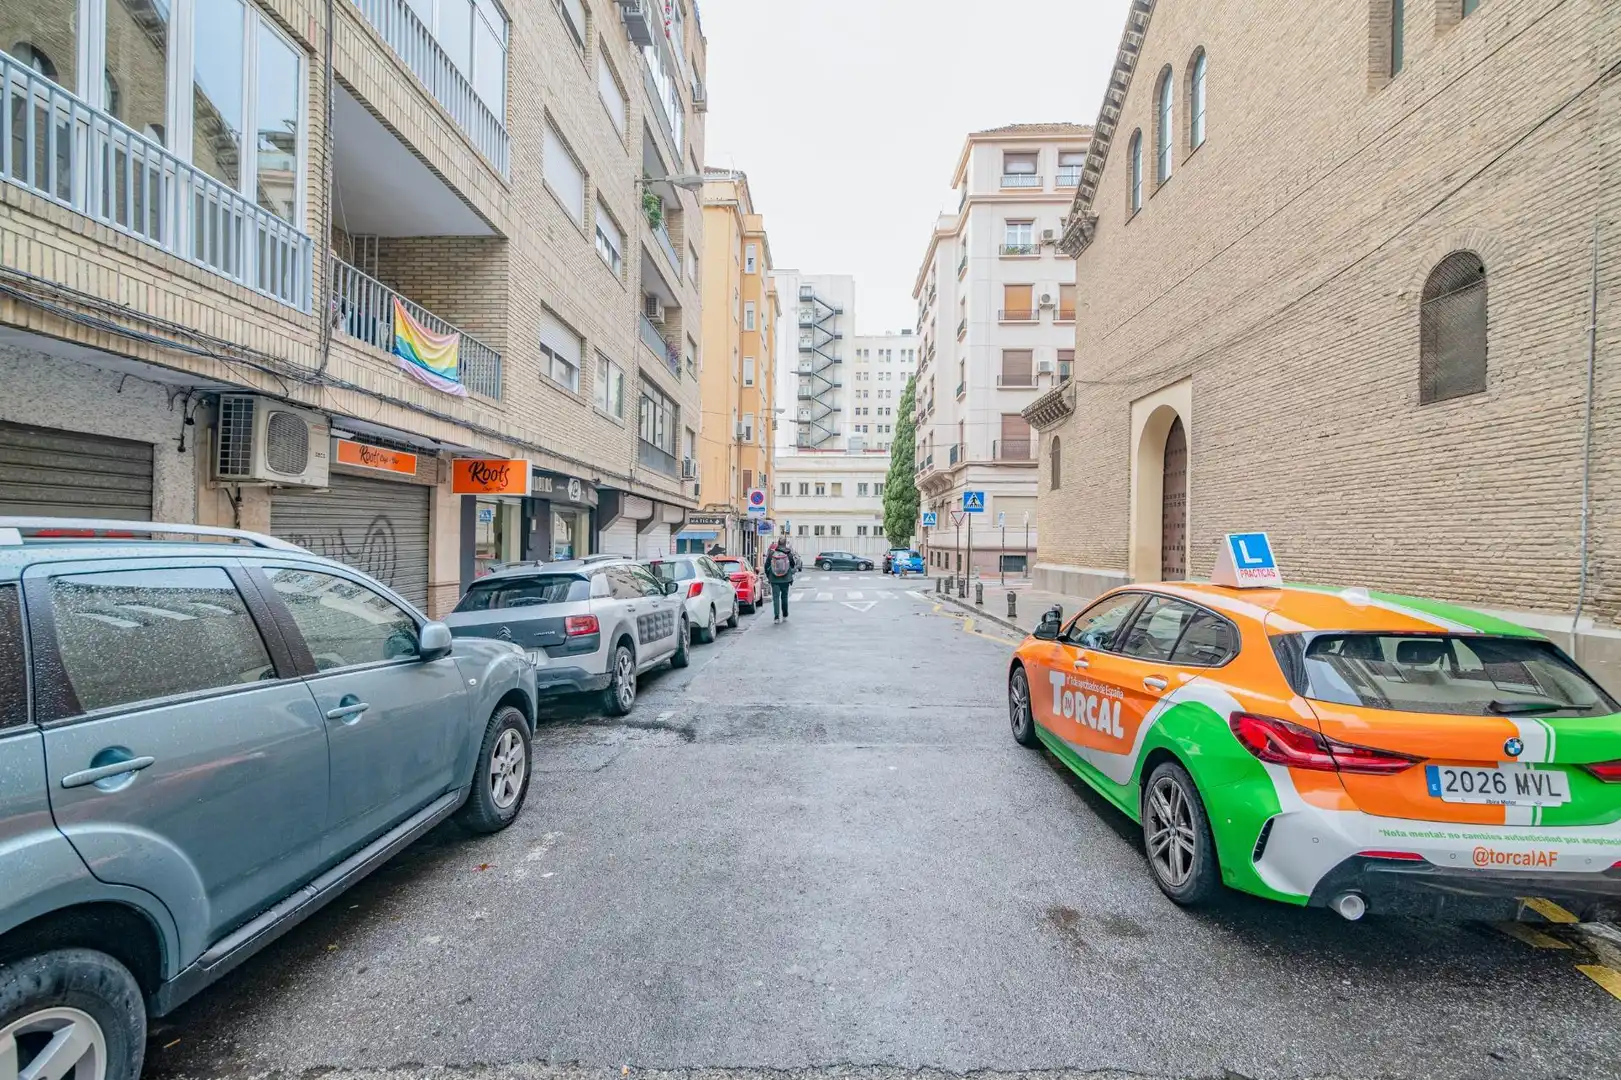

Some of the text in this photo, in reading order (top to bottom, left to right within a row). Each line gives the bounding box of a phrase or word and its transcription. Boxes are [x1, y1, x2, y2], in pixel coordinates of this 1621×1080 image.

[359, 445, 380, 467] Roots
[468, 461, 511, 487] Roots
[1238, 540, 1263, 564] L
[1105, 685, 1124, 699] España
[1444, 769, 1562, 797] 2026 MVL
[1473, 846, 1558, 867] @torcalAF
